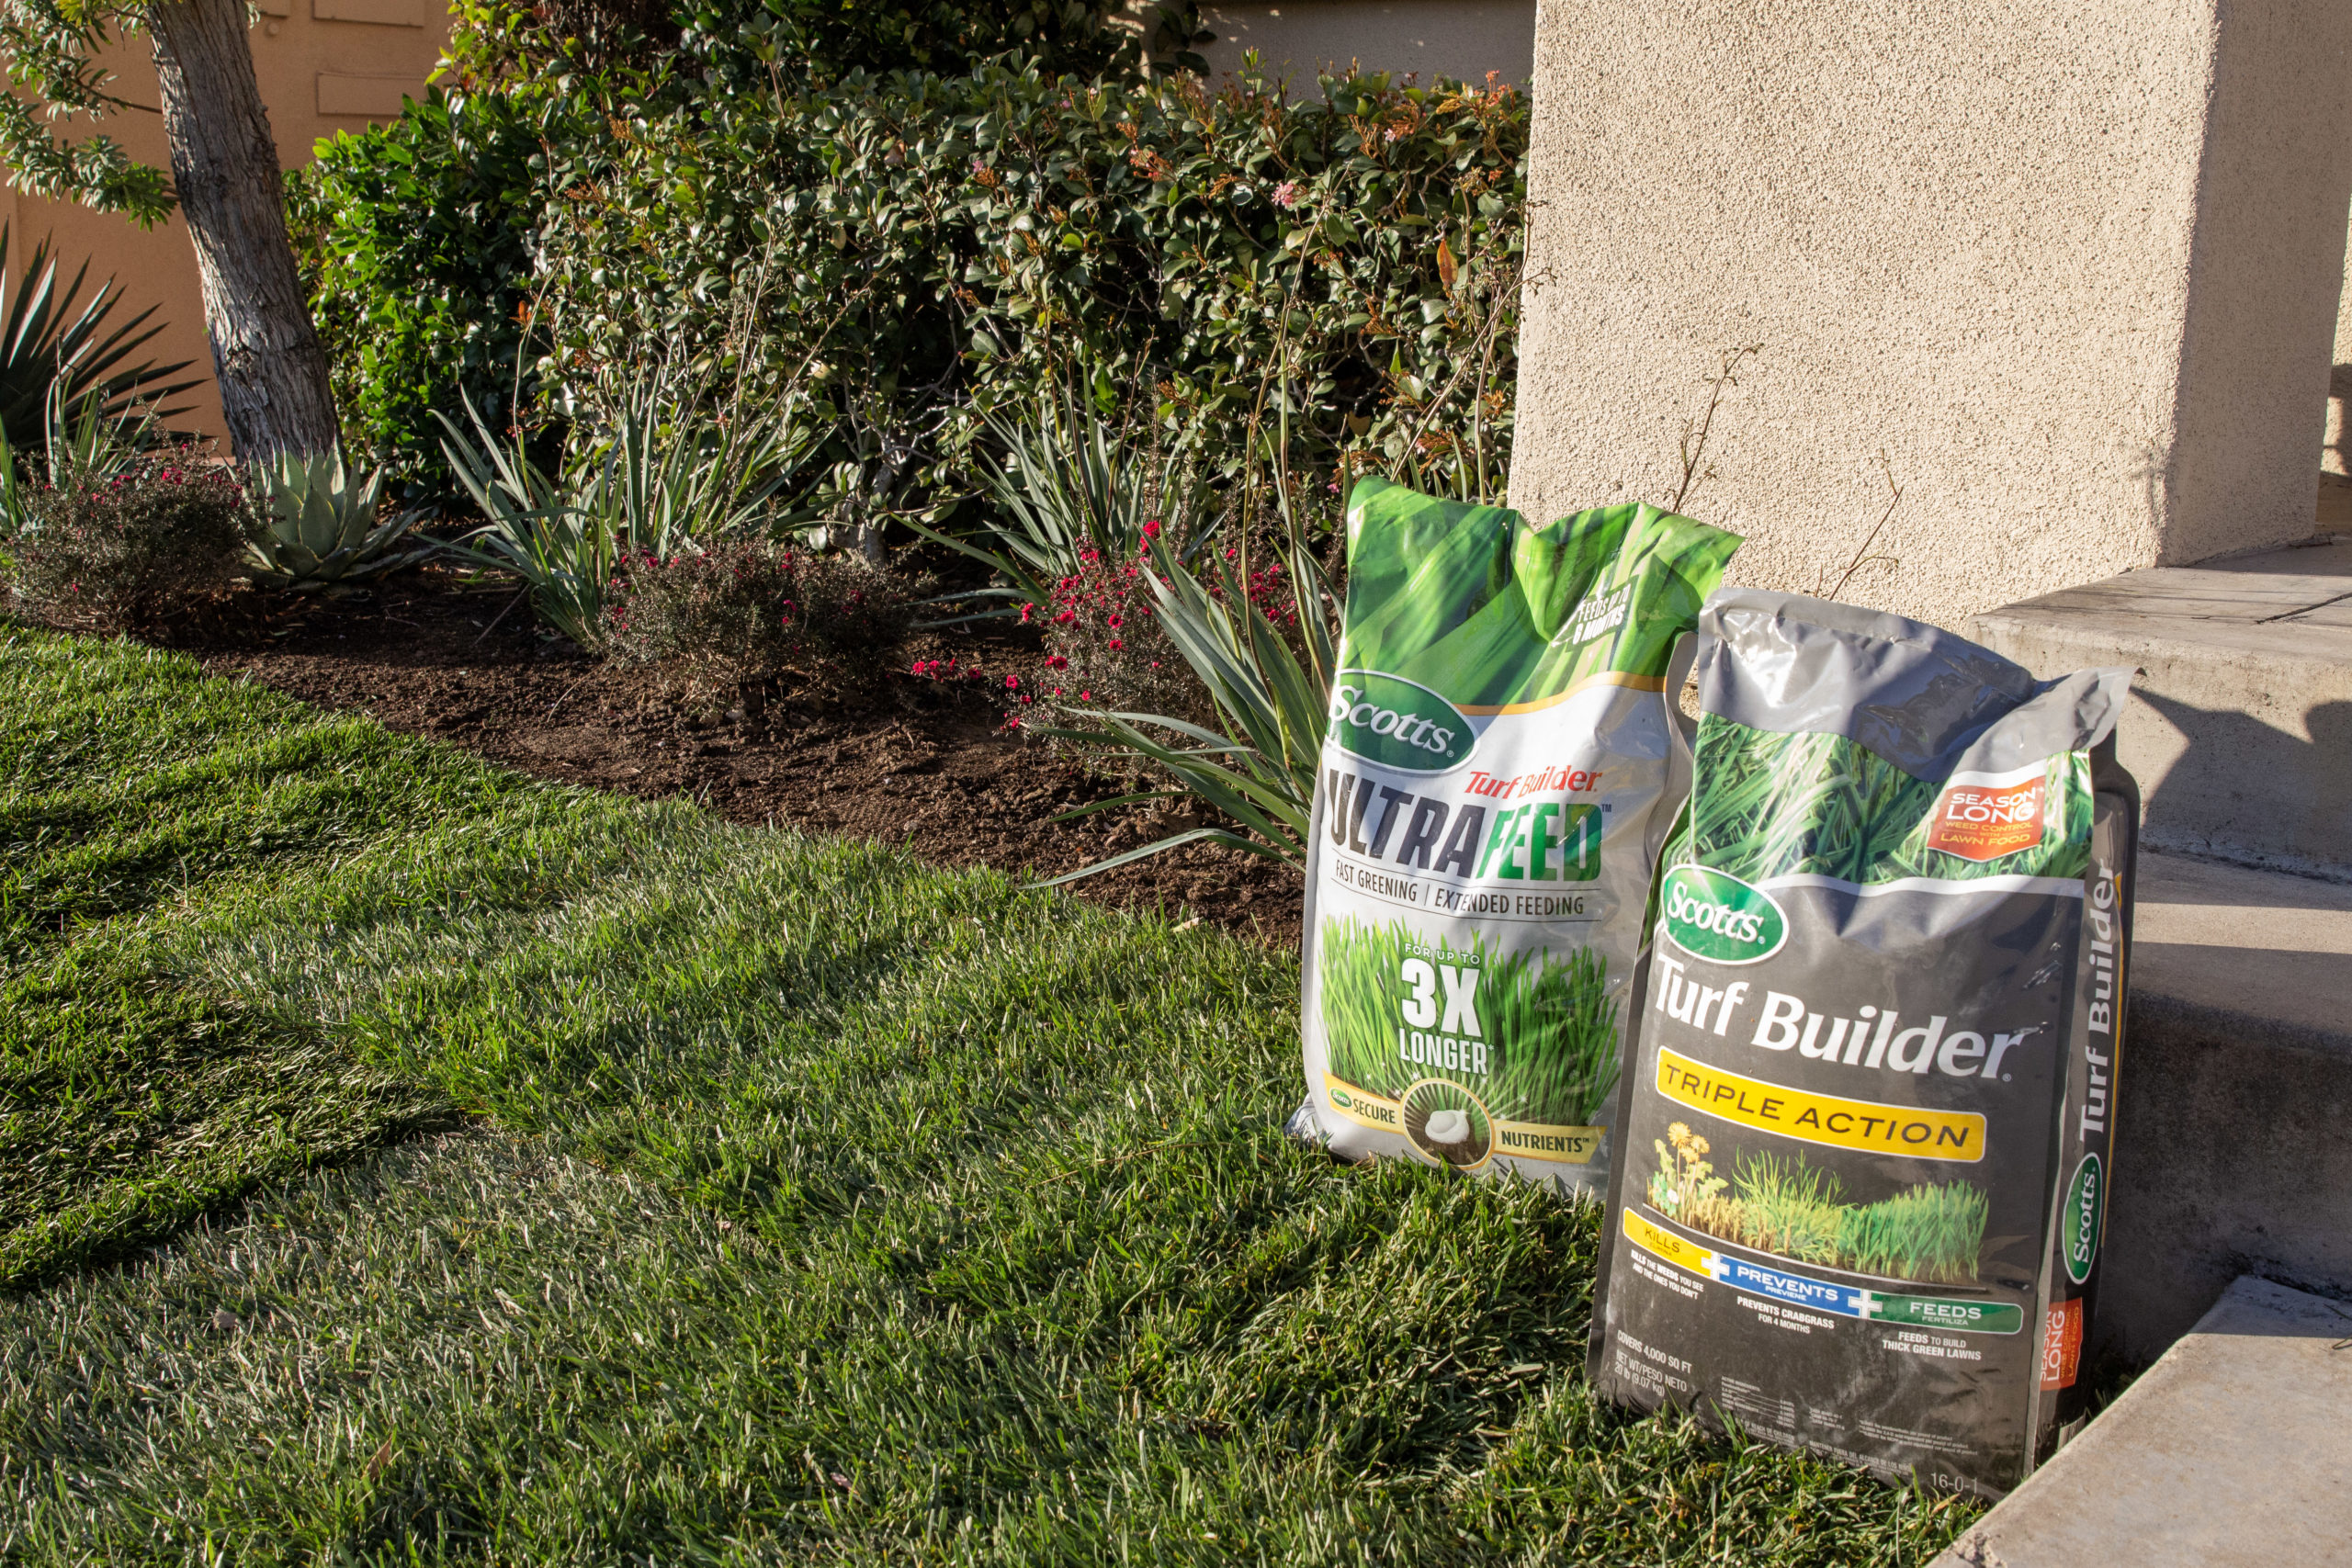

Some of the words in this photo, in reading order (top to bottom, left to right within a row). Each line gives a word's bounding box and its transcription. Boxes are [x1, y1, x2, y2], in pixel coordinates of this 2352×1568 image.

[1577, 597, 1609, 623] FEEDS
[1580, 604, 1626, 642] MONTHS
[1329, 685, 1455, 754] Scotts
[1464, 771, 1521, 799] Turf
[1518, 765, 1603, 797] Builder
[1951, 786, 2037, 808] SEASON
[1329, 768, 1603, 882] ULTRAFEED
[1945, 820, 1979, 830] WEED
[1981, 821, 2033, 832] CONTROL
[1946, 801, 2036, 824] LONG
[1940, 833, 1984, 846] LAWN
[1988, 833, 2030, 846] FOOD
[1336, 859, 1354, 884] FAST
[1358, 870, 1418, 902] GREENING
[1435, 888, 1510, 914] EXTENDED
[1516, 896, 1584, 916] FEEDING
[1668, 880, 1765, 942] Scotts
[1405, 942, 1430, 958] FOR
[1437, 949, 1454, 962] UP
[1461, 953, 1480, 964] TO
[2088, 858, 2114, 1035] Builder
[1401, 957, 1483, 1037] 3X
[1656, 953, 1750, 1037] Turf
[1751, 989, 2023, 1079] Builder
[1352, 1098, 1396, 1124] SECURE
[1665, 1064, 1784, 1121] TRIPLE
[1794, 1107, 1970, 1148] ACTION
[2080, 1045, 2109, 1144] Turf
[1501, 1130, 1583, 1154] NUTRIENTS
[2074, 1171, 2096, 1264] Scotts
[1645, 1227, 1680, 1254] KILLS
[1631, 1249, 1646, 1263] KILLS
[1646, 1256, 1657, 1269] THE
[1657, 1263, 1679, 1281] WEEDS
[1679, 1275, 1692, 1287] YOU
[1692, 1280, 1704, 1292] SEE
[1633, 1262, 1644, 1274] AND
[1644, 1269, 1654, 1280] THE
[1654, 1273, 1668, 1287] ONES
[1668, 1280, 1680, 1292] YOU
[1680, 1286, 1699, 1300] DON'T
[1737, 1266, 1838, 1302] PREVENTS
[1765, 1286, 1807, 1302] PREVIENE
[1910, 1302, 1982, 1320] FEEDS
[1737, 1296, 1780, 1316] PREVENTS
[1781, 1308, 1835, 1330] CRABGRASS
[1758, 1314, 1773, 1325] FOR
[1773, 1318, 1779, 1326] 4
[1780, 1320, 1811, 1335] MONTHS
[1922, 1315, 1969, 1326] FERTILIZA
[1617, 1330, 1643, 1353] COVERS
[1644, 1345, 1667, 1364] 4,000
[1668, 1355, 1680, 1371] SQ
[1681, 1360, 1692, 1374] FT
[1883, 1339, 1910, 1353] THICK
[1913, 1344, 1944, 1357] GREEN
[1947, 1348, 1982, 1361] LAWNS
[1898, 1331, 1928, 1344] FEEDS
[1930, 1336, 1941, 1346] TO
[1942, 1337, 1966, 1348] BUILD
[2047, 1310, 2065, 1382] LONG
[1614, 1361, 1623, 1375] 20
[1623, 1368, 1631, 1380] lb
[1632, 1372, 1651, 1390] (9.07
[1653, 1381, 1665, 1397] kg)
[1617, 1349, 1628, 1365] NET
[1629, 1358, 1663, 1383] WT/PESO
[1665, 1374, 1688, 1393] NETO
[1930, 1472, 1977, 1495] 16-0-1
